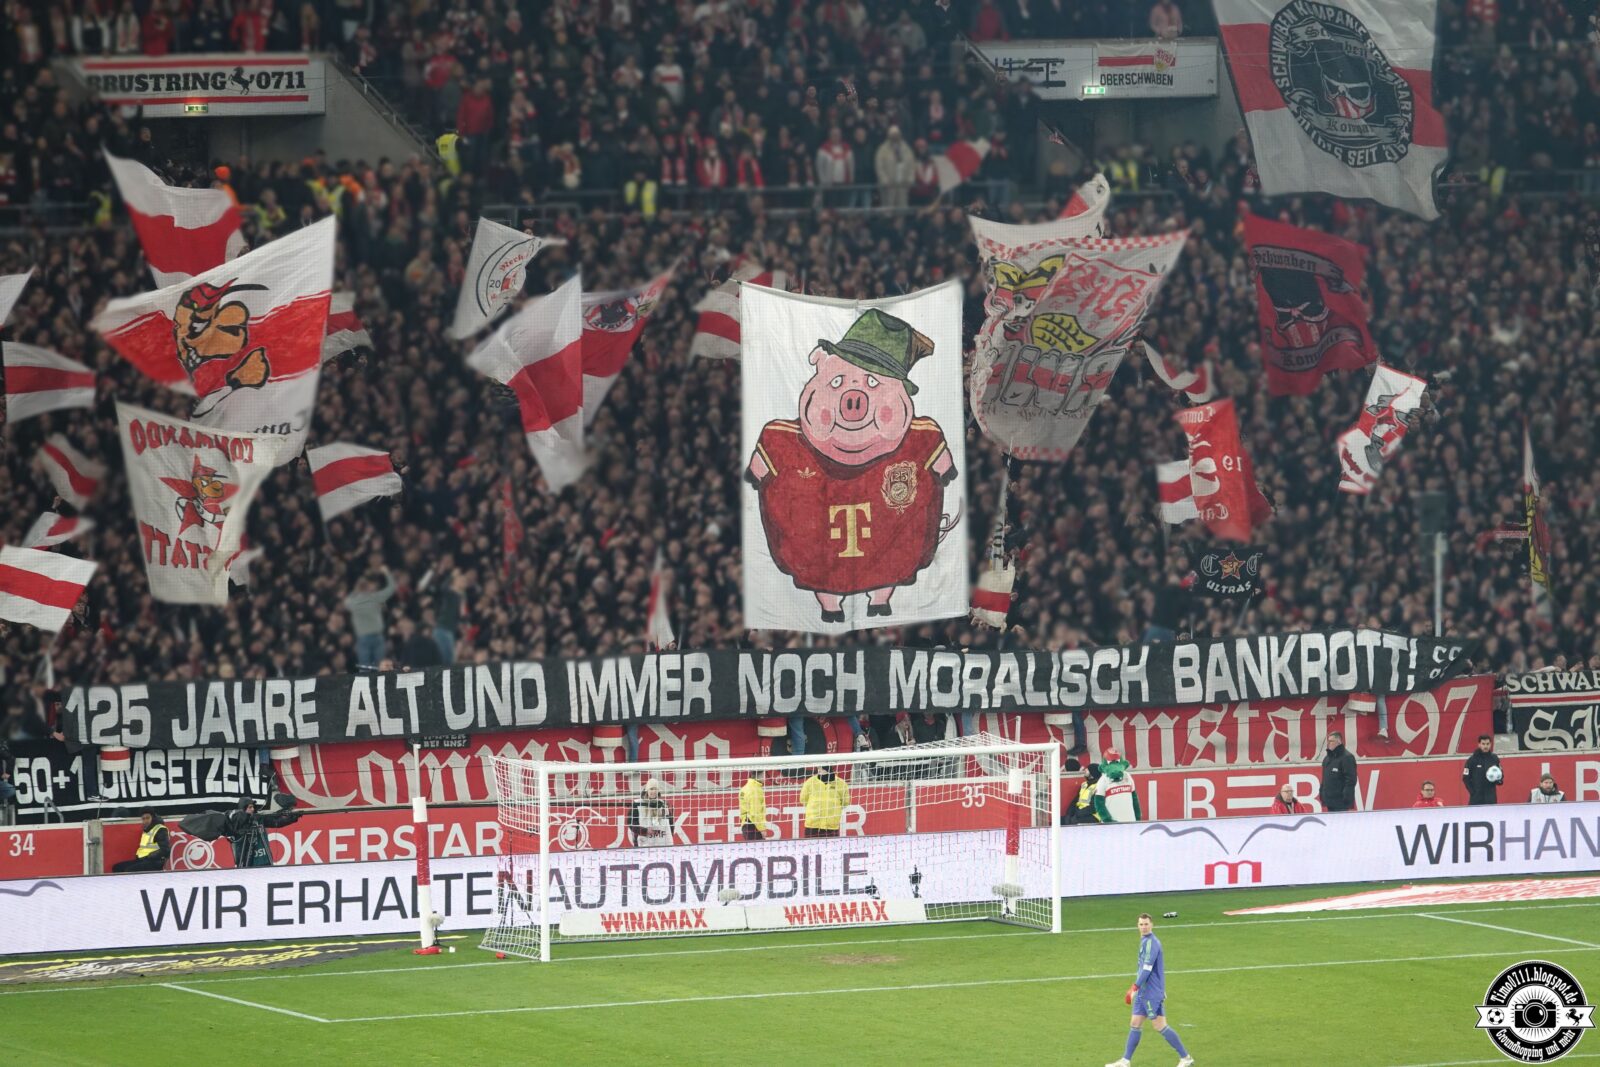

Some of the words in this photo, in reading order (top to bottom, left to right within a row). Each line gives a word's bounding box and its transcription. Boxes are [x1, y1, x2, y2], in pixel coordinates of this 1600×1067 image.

[87, 72, 227, 92] BRUSTRING
[256, 71, 306, 89] 0711
[1100, 72, 1174, 87] OBERSCHWABEN
[1348, 147, 1378, 166] SEIT
[1206, 580, 1252, 594] ULTRAS
[64, 683, 151, 748] 125
[172, 677, 320, 748] JAHRE
[345, 671, 425, 738] ALT
[443, 661, 548, 732] UND
[567, 651, 712, 724] IMMER
[737, 649, 866, 714] NOCH
[889, 645, 1150, 710] MORALISCH
[1172, 629, 1418, 703] BANKROTT!
[1394, 684, 1478, 758] 97
[14, 755, 85, 805] 50+1
[962, 785, 986, 808] 35
[9, 833, 36, 857] 34
[266, 820, 504, 866] OKERSTAR
[537, 851, 870, 911] AUTOMOBILE
[140, 884, 248, 932] WIR
[600, 908, 708, 933] WINAMAX
[784, 900, 887, 926] WINAMAX
